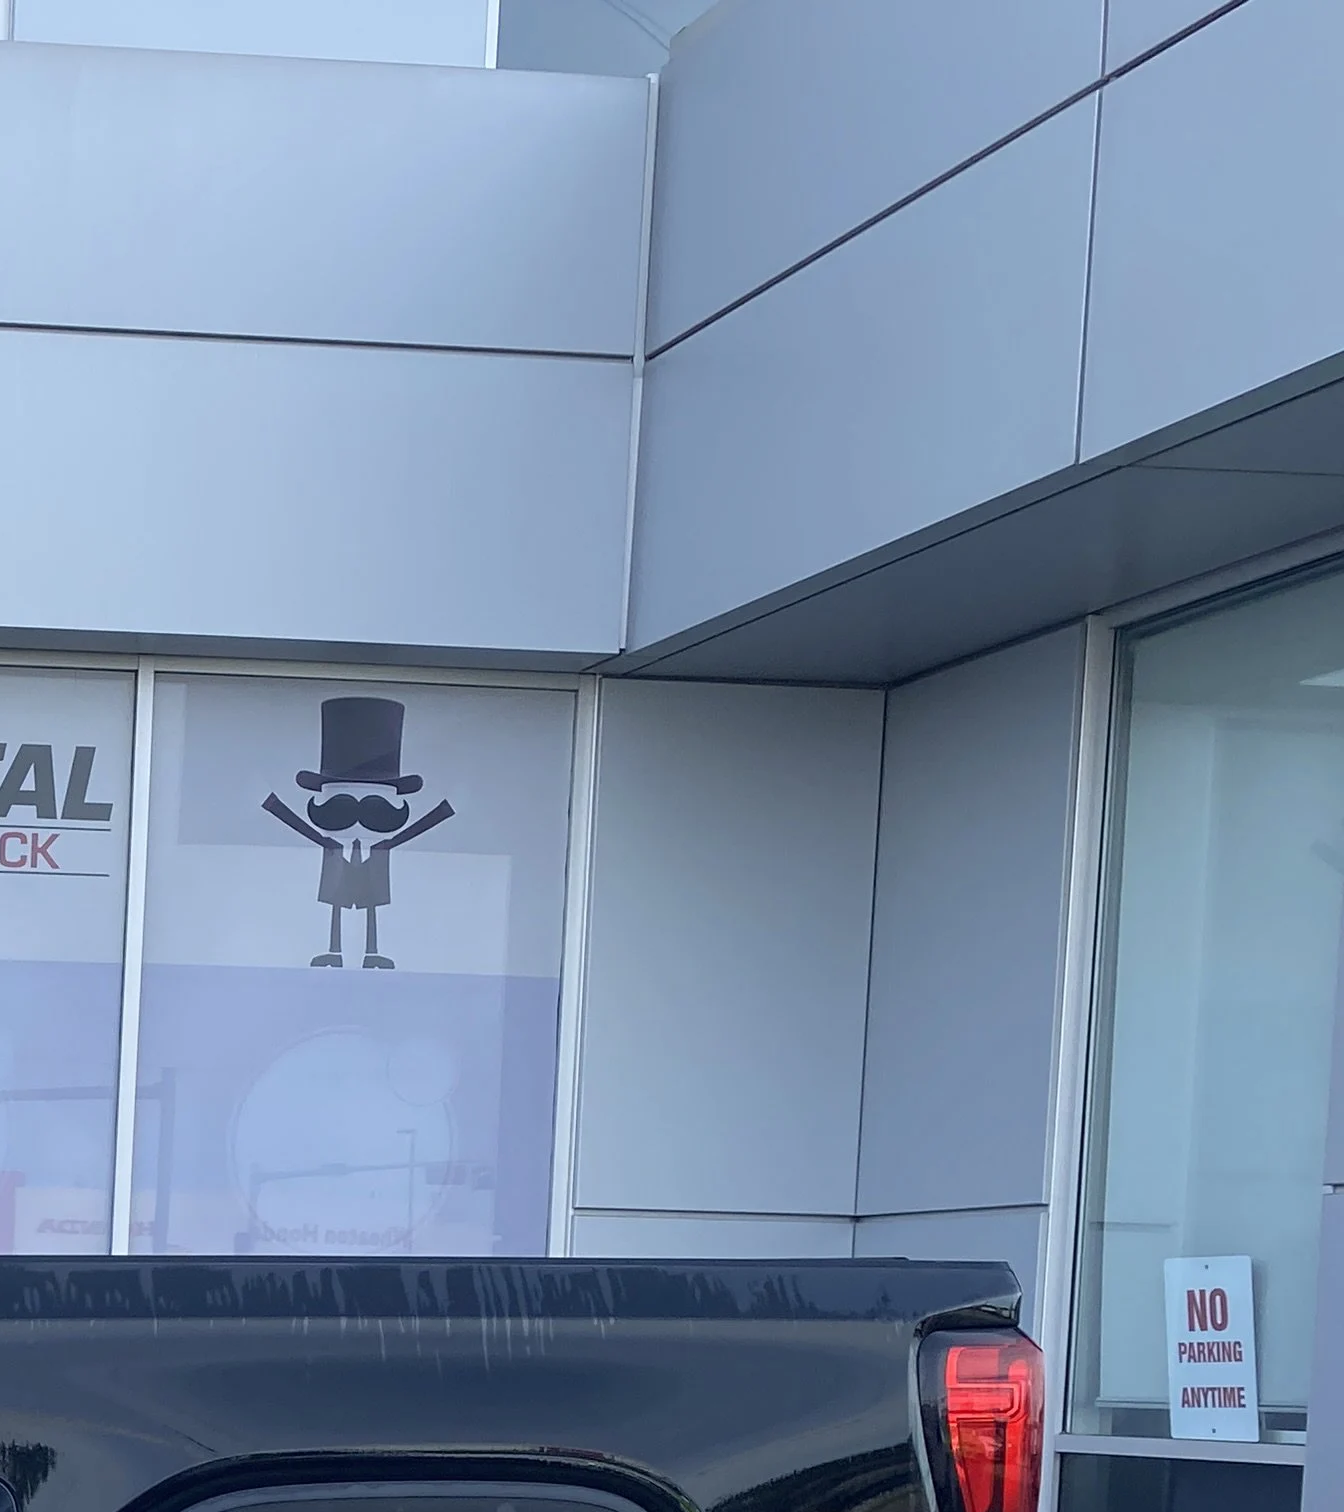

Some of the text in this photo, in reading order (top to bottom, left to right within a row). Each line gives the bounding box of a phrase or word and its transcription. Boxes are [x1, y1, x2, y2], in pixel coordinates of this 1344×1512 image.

[1186, 1288, 1228, 1332] NO
[1178, 1341, 1243, 1363] PARKING
[1181, 1387, 1246, 1408] ANYTIME
